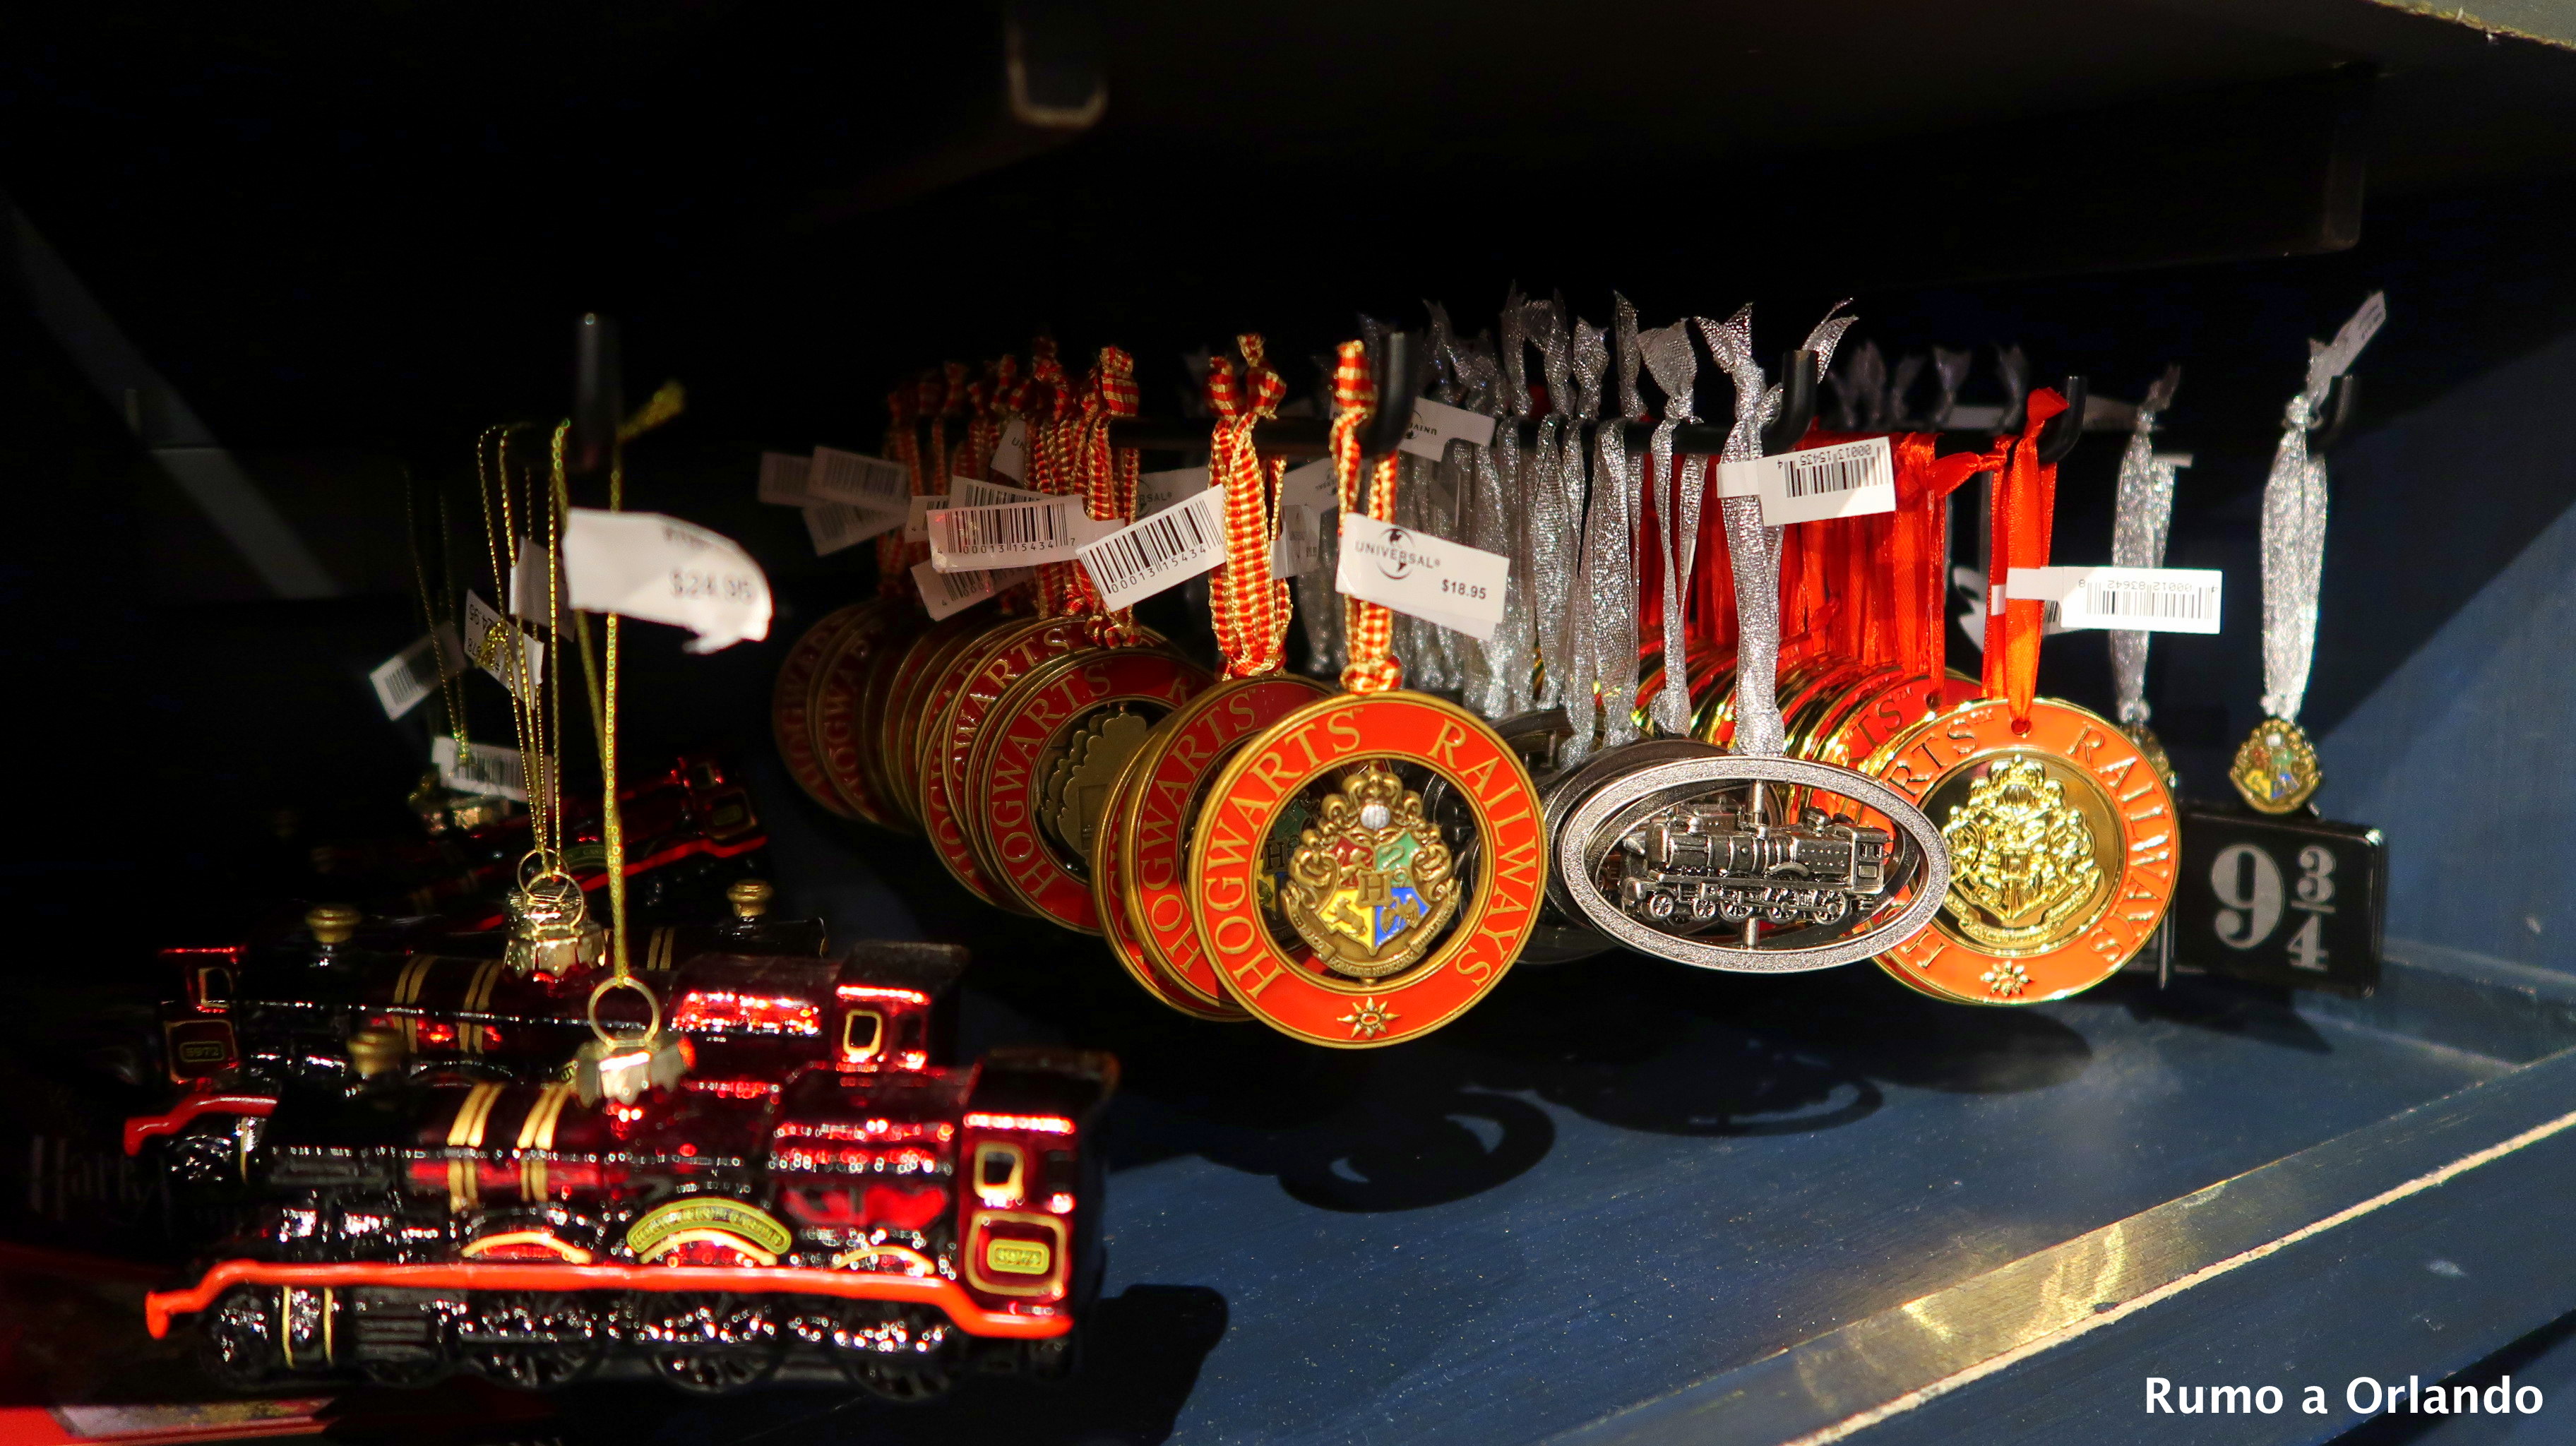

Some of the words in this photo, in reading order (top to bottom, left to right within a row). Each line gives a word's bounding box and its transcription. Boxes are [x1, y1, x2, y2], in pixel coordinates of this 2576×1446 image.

[962, 544, 1004, 554] 00013
[1013, 541, 1054, 552] 15434
[1070, 538, 1075, 546] 7
[1111, 568, 1156, 594] 00013
[1162, 546, 1207, 570] 15434
[1441, 578, 1486, 600] $18.95
[2078, 578, 2086, 588] 8
[2106, 579, 2146, 590] 83642
[991, 662, 1111, 899] HOGWARTS
[1141, 692, 1256, 974] HOGWARTS
[1205, 710, 1363, 1000] HOGWARTS
[1427, 719, 1530, 988] RAILWAYS
[2070, 722, 2171, 963] RAILWAYS
